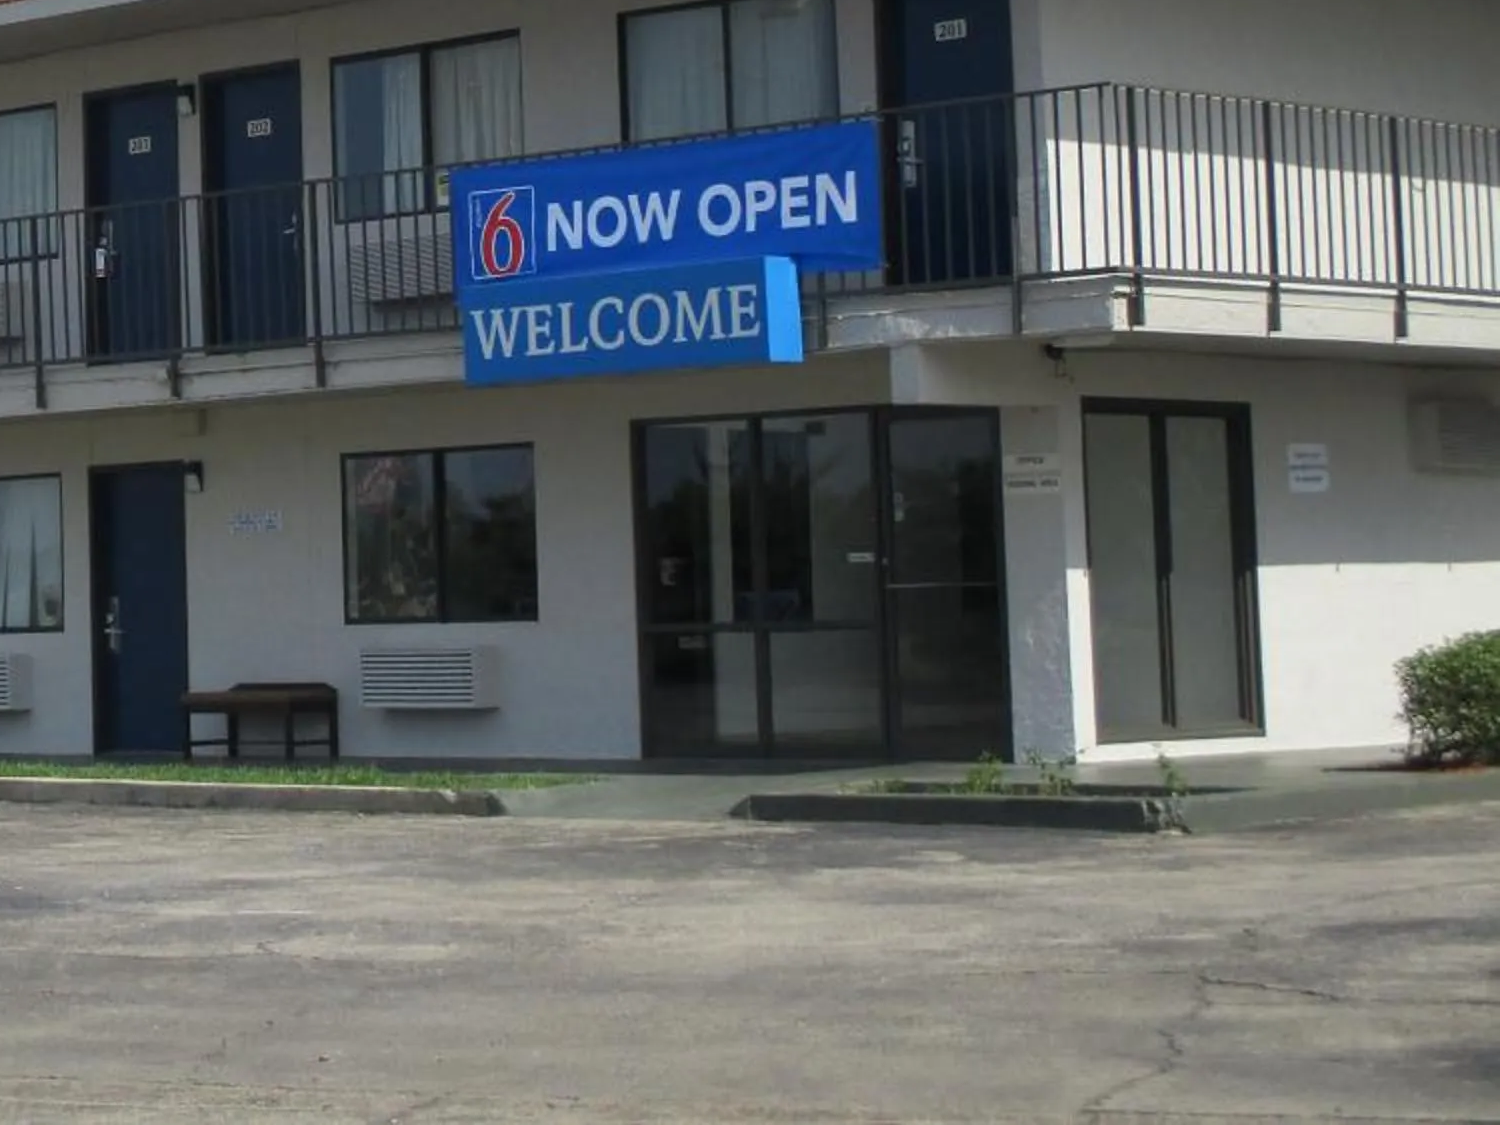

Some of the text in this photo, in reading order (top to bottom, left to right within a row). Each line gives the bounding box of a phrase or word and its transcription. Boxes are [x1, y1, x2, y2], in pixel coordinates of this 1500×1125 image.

[481, 191, 524, 278] 6
[547, 190, 680, 252] NOW
[697, 171, 858, 238] OPEN
[470, 284, 761, 360] WELCOME
